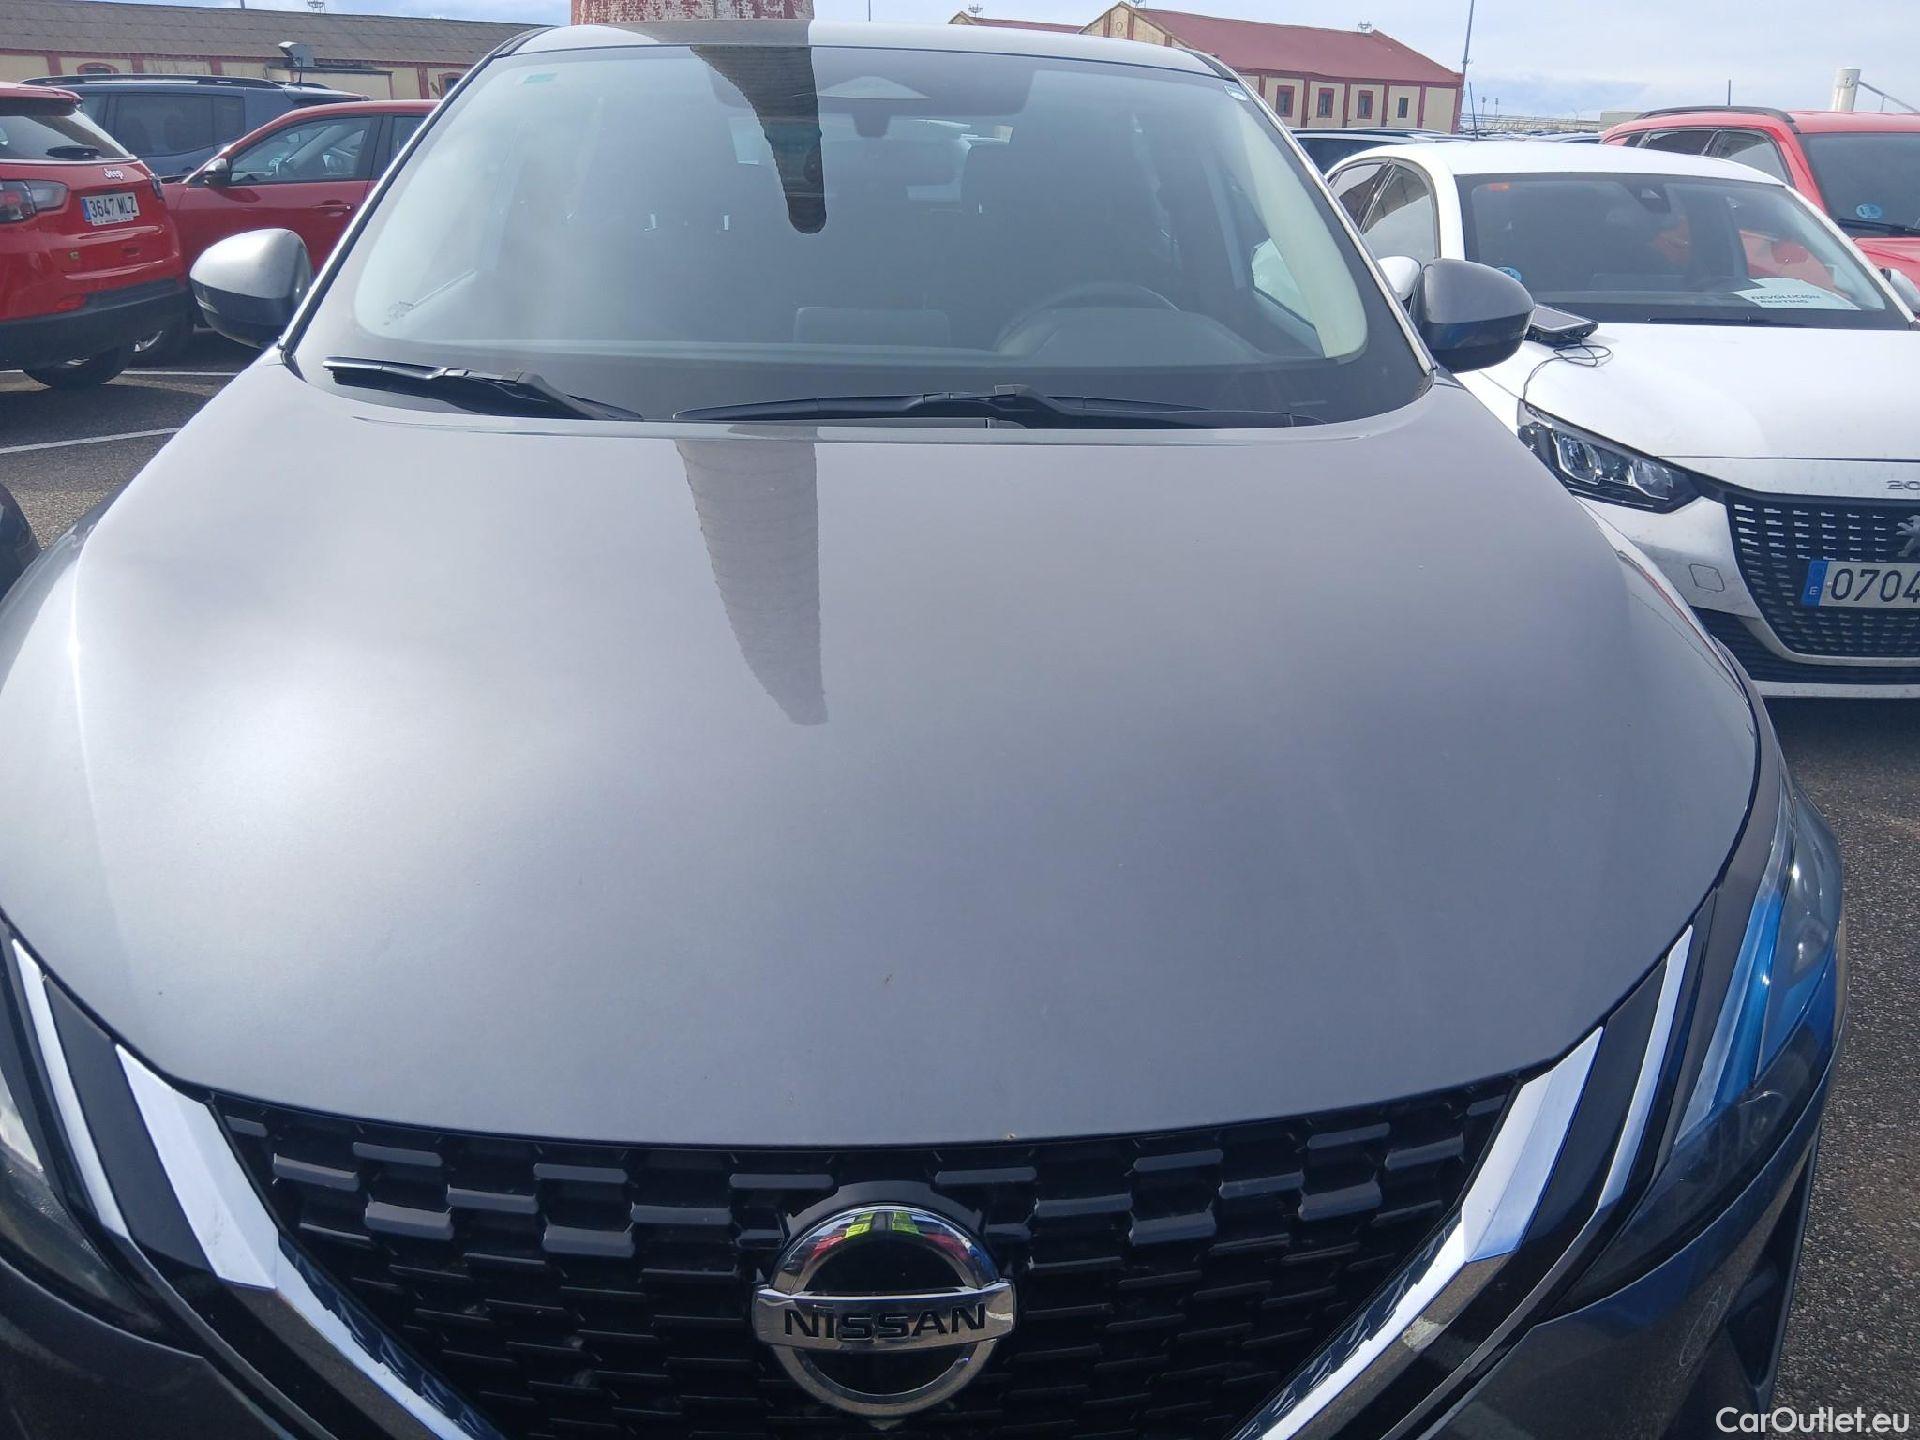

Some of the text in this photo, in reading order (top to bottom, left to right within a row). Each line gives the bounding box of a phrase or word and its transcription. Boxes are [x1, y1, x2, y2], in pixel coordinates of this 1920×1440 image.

[103, 167, 124, 180] Jeep
[89, 196, 136, 218] 3647 MLZ
[784, 1302, 986, 1343] NISSAN
